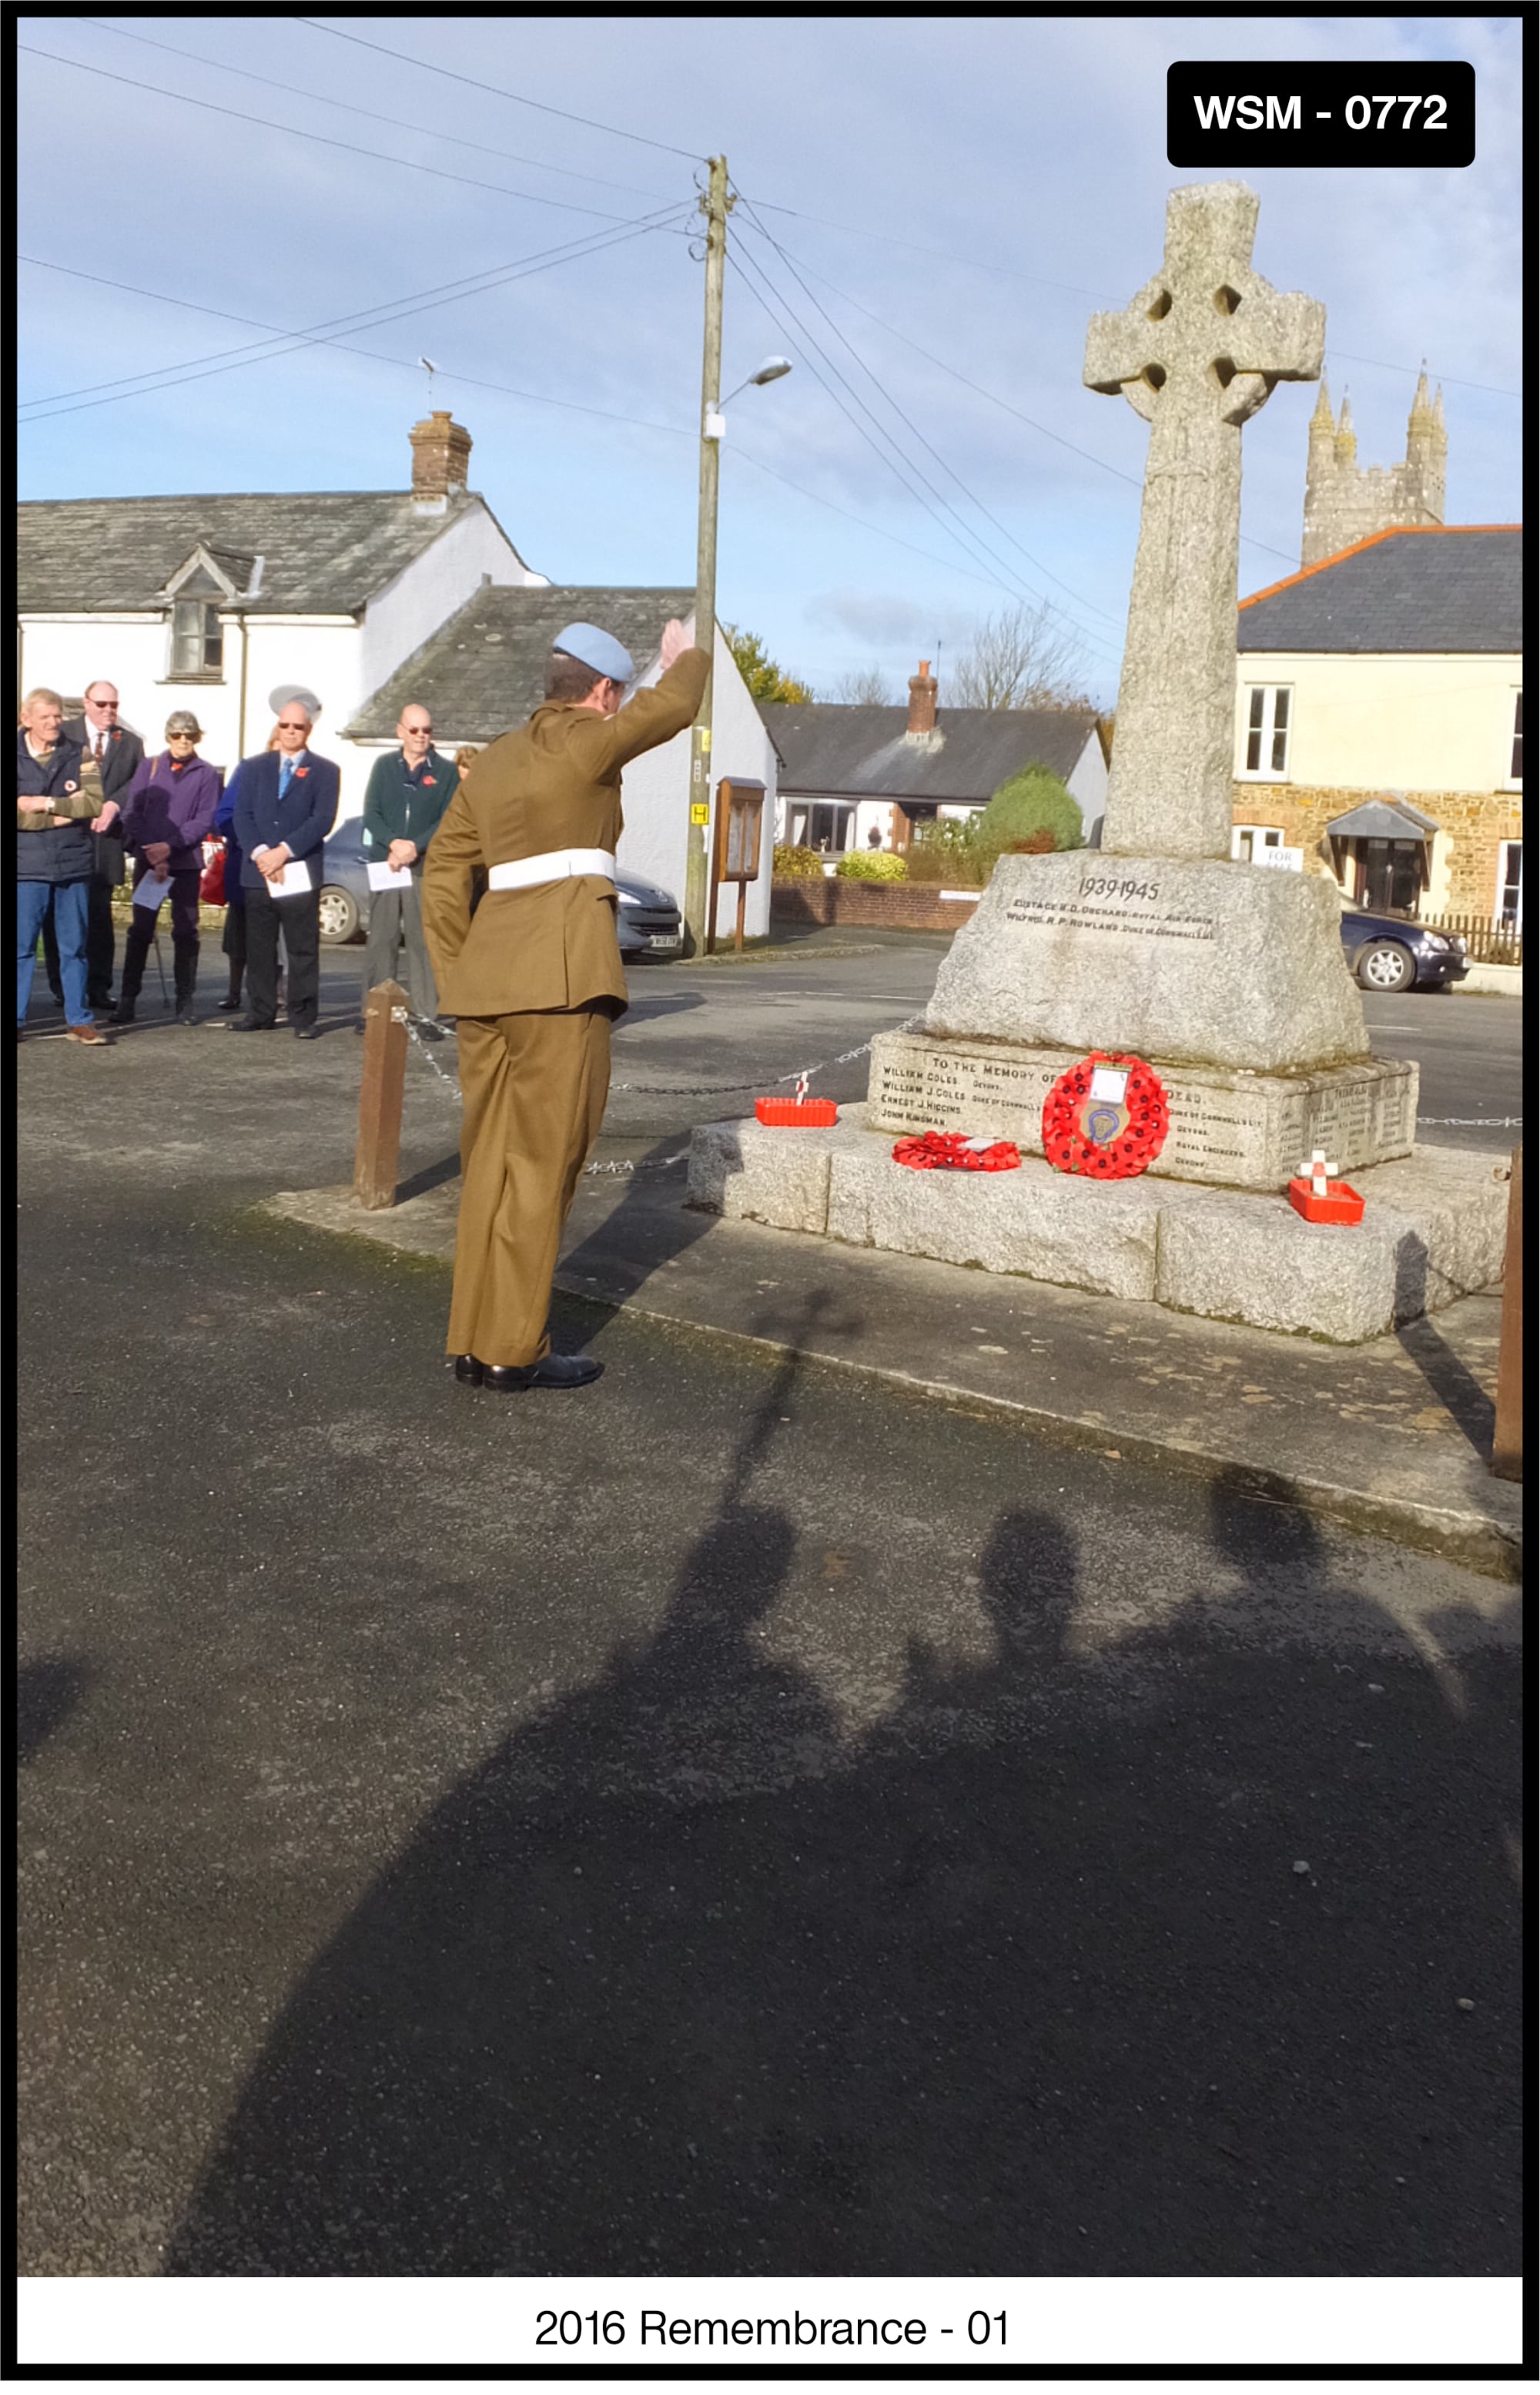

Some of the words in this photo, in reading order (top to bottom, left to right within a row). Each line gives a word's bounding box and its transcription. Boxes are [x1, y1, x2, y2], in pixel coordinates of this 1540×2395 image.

[694, 806, 707, 822] H
[1268, 850, 1292, 861] FOR
[1079, 877, 1160, 902] 1939-1945
[1013, 899, 1055, 911] EUSTACE
[883, 1066, 923, 1079] WILLIAM
[932, 1057, 949, 1069] TO
[954, 1062, 976, 1074] THE
[983, 1064, 1035, 1080] MEMORY
[1042, 1074, 1057, 1083] OF
[882, 1080, 922, 1094] WILLIAM
[881, 1094, 914, 1107] ERNEST
[882, 1109, 904, 1118] JOHN
[1176, 1141, 1201, 1151] ROYAL
